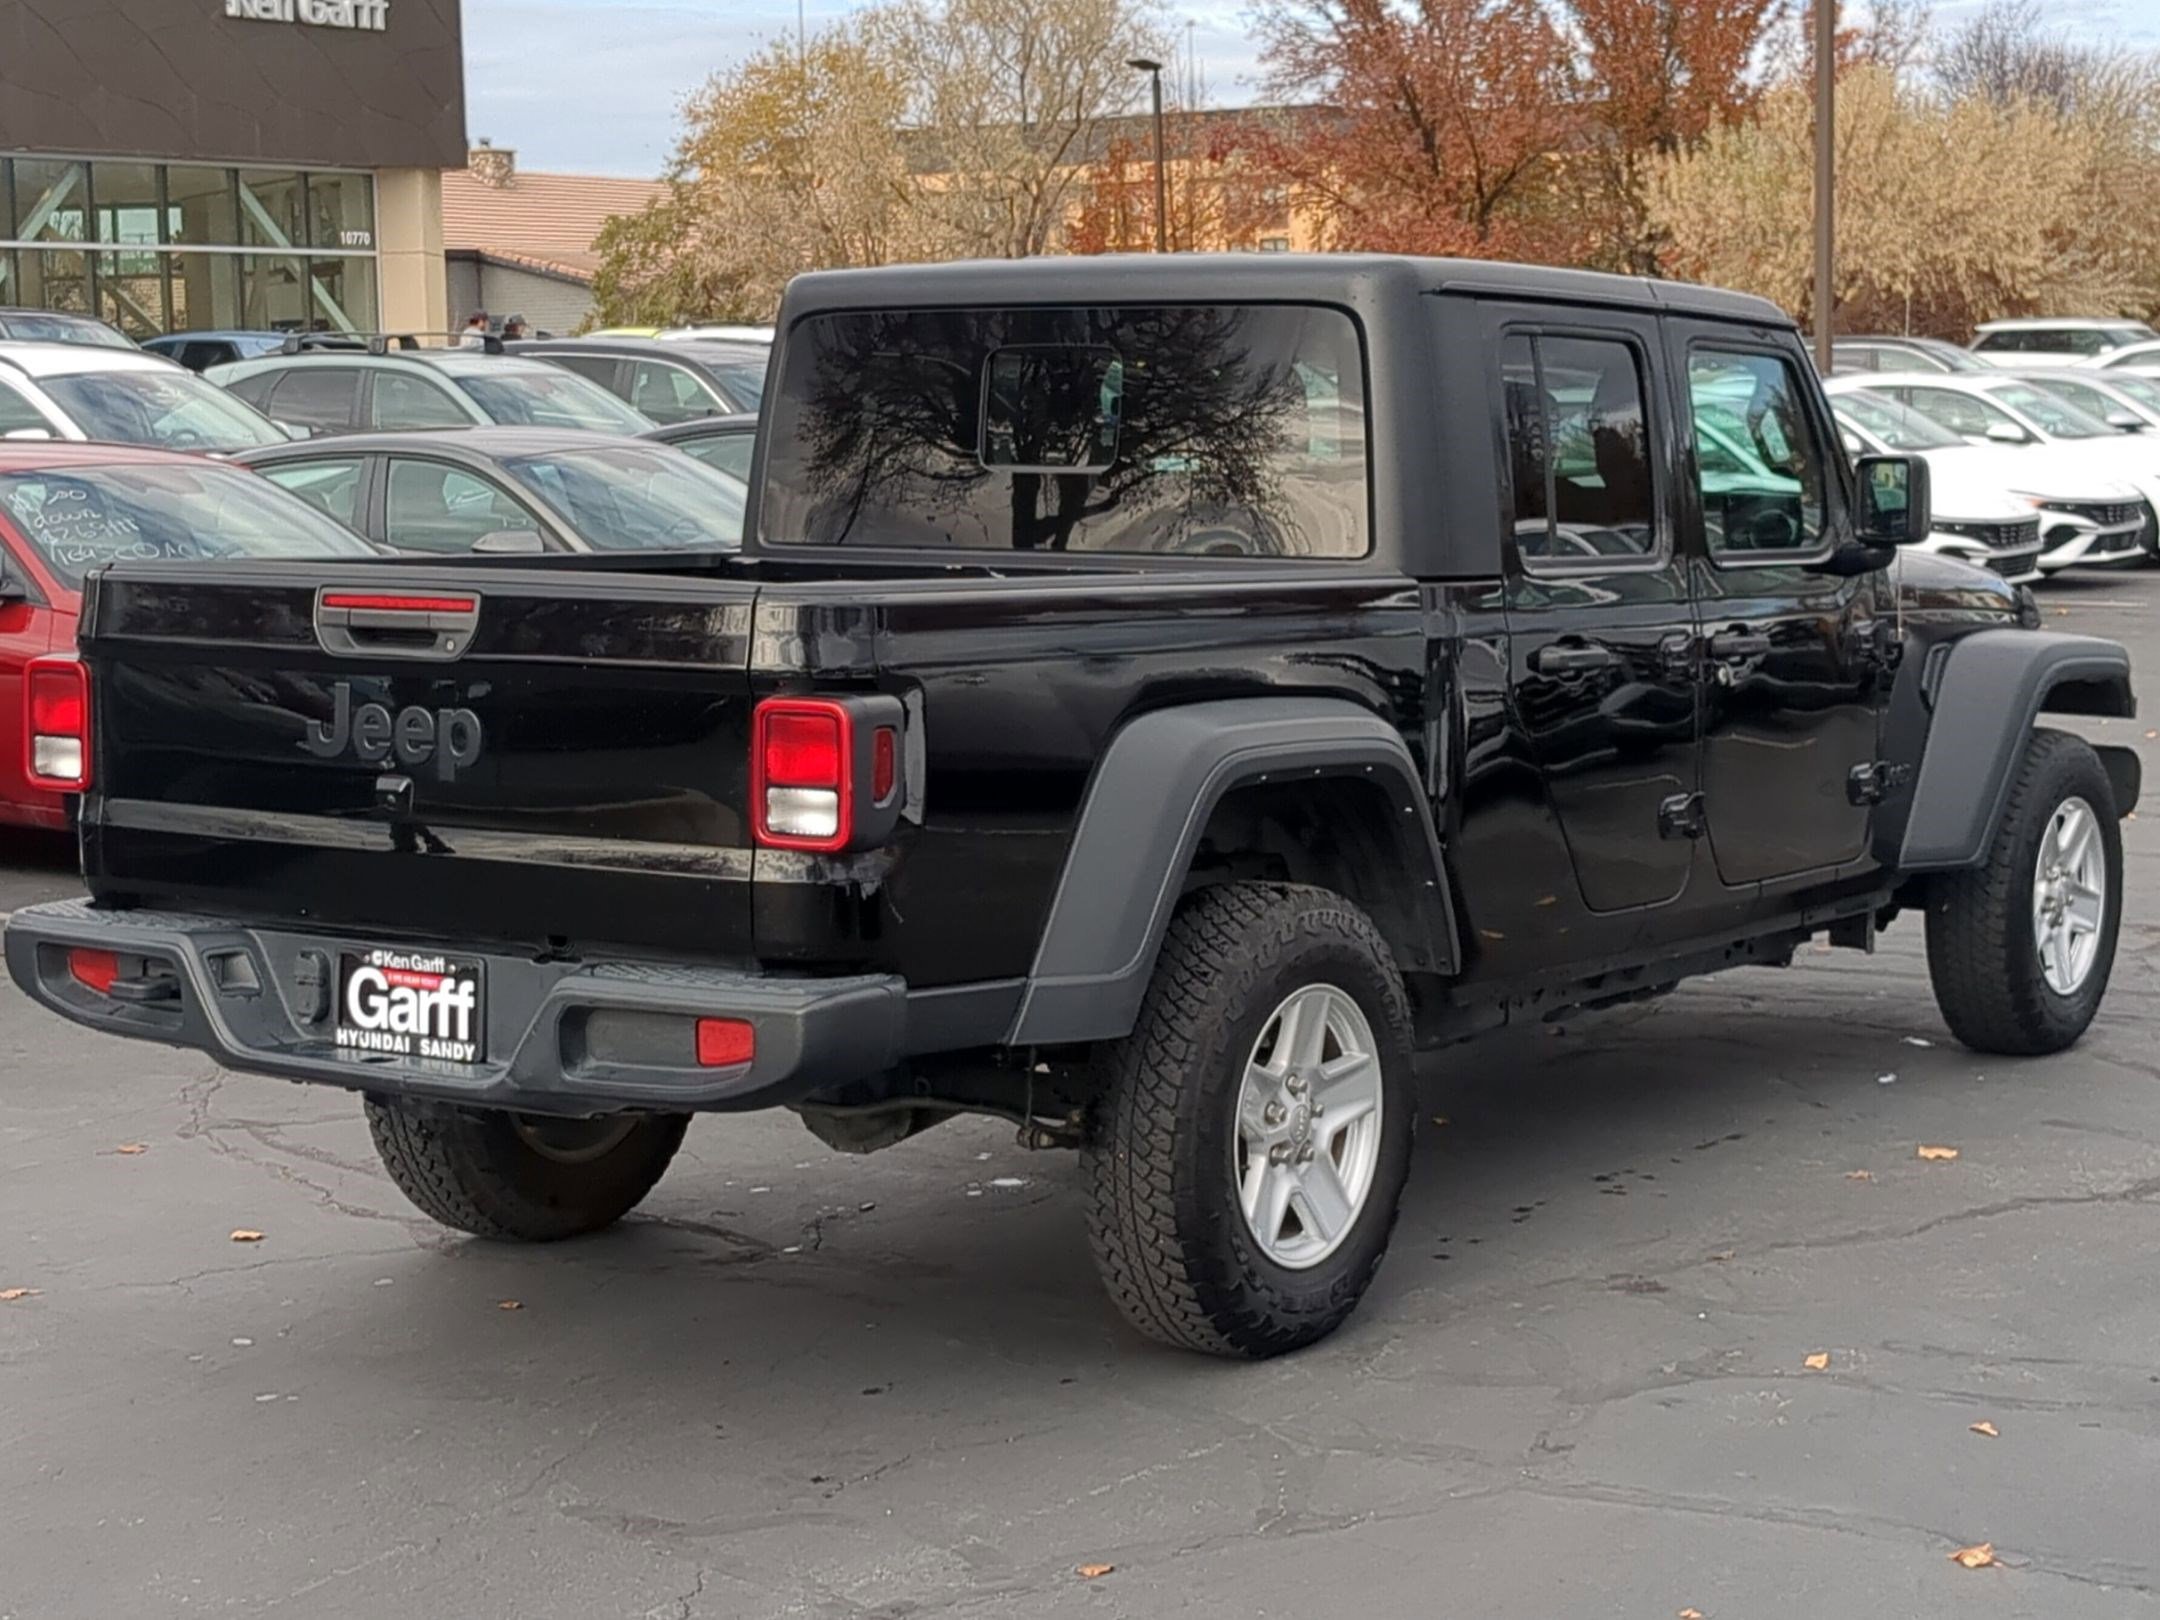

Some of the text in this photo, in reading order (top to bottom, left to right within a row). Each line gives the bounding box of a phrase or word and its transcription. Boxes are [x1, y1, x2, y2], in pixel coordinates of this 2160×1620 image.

[226, 0, 389, 31] Ken Garff
[340, 231, 371, 246] 10770
[306, 682, 483, 781] Jeep
[383, 951, 446, 973] Ken Garff
[347, 966, 475, 1041] Garff
[336, 1028, 476, 1062] HYUNDAI SANDY
